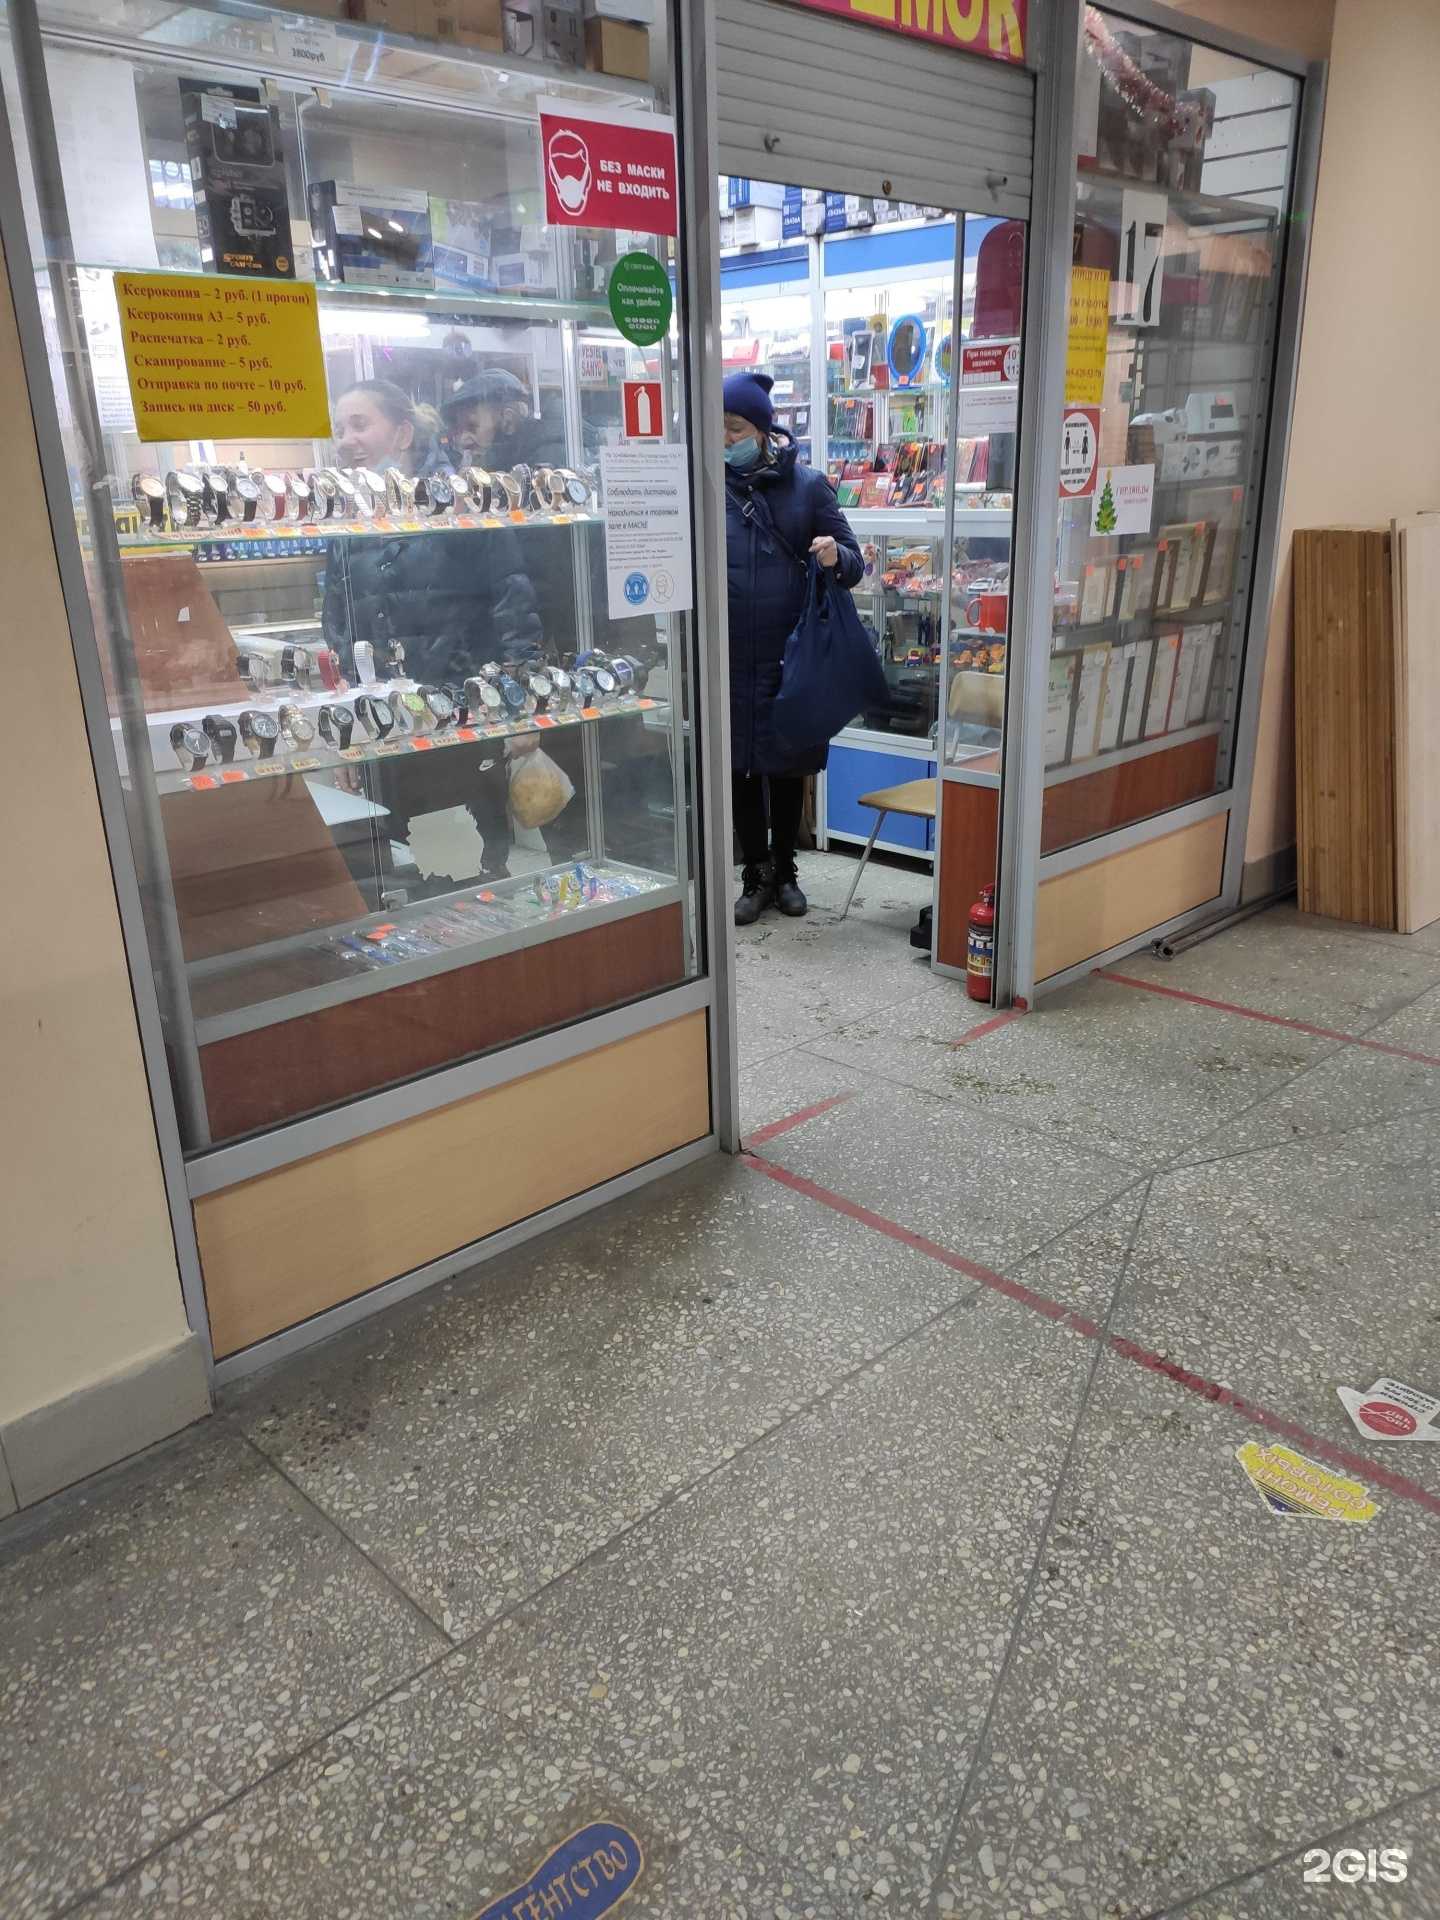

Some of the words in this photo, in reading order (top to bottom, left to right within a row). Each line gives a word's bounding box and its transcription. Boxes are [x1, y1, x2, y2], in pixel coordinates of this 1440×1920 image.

[599, 159, 621, 174] БЕЗ
[627, 163, 665, 180] МАСКИ
[596, 179, 613, 193] НЕ
[618, 182, 670, 200] ВХОДИТЬ
[123, 283, 200, 299] Ксерокопия
[214, 288, 220, 300] 2
[224, 289, 249, 304] руб.
[252, 289, 262, 303] (1
[266, 292, 311, 307] прогон)
[127, 307, 203, 323] Ксерокопия
[207, 310, 224, 323] А3
[237, 311, 244, 324] 5
[247, 312, 271, 326] руб.
[130, 331, 204, 346] Распечатка
[217, 334, 224, 345] 2
[227, 335, 250, 348] руб.
[134, 353, 226, 370] Сканирование
[239, 356, 245, 368] 5
[249, 357, 273, 371] руб.
[1007, 350, 1019, 360] 10
[137, 377, 200, 393] Отправка
[204, 380, 218, 390] по
[222, 380, 256, 391] почте
[268, 379, 281, 391] 10
[284, 379, 307, 394] руб.
[141, 400, 185, 414] Запись
[189, 402, 203, 413] на
[207, 402, 235, 414] диск
[247, 401, 260, 413] 50
[264, 402, 286, 416] руб.
[1256, 1449, 1367, 1510] СОТОВЫХ
[1256, 1468, 1345, 1520] РЕМОНТ
[501, 1840, 628, 1920] ГЕНТСТВО
